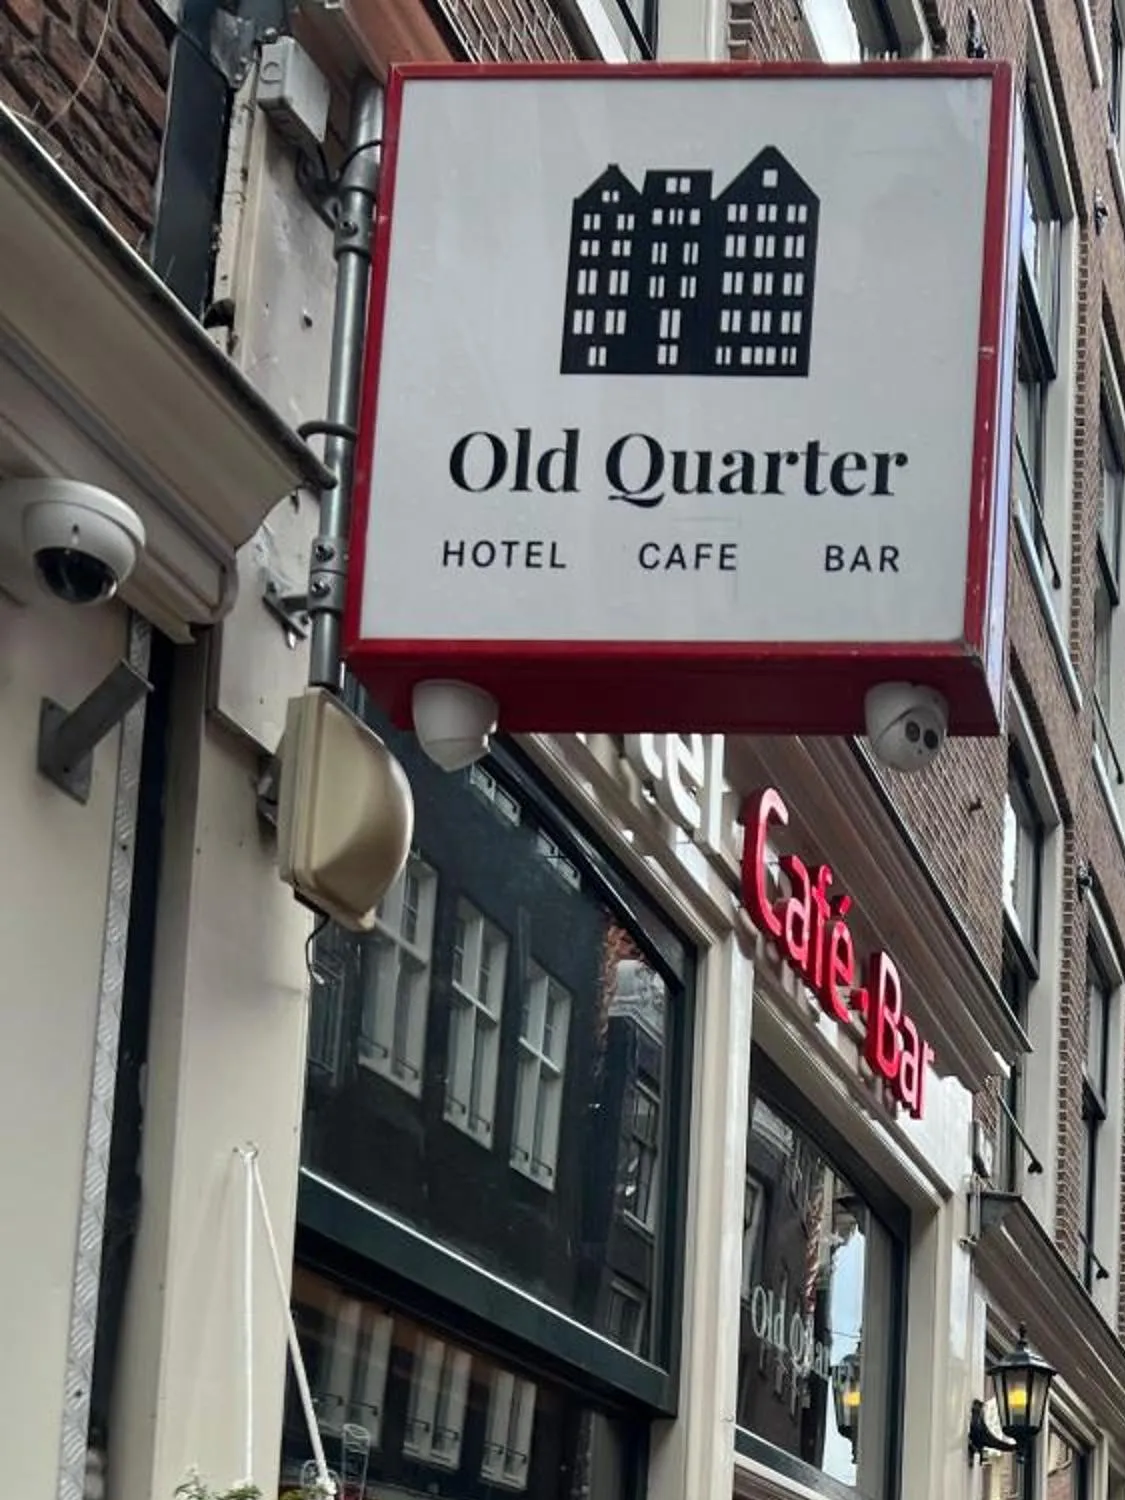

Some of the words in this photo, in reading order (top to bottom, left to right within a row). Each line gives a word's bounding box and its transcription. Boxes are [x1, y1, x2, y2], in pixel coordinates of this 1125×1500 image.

[449, 428, 580, 493] Old
[605, 433, 908, 508] Quarter
[443, 539, 567, 569] HOTEL
[638, 542, 738, 571] CAFE
[824, 544, 900, 573] BAR
[751, 1285, 788, 1348] Old
